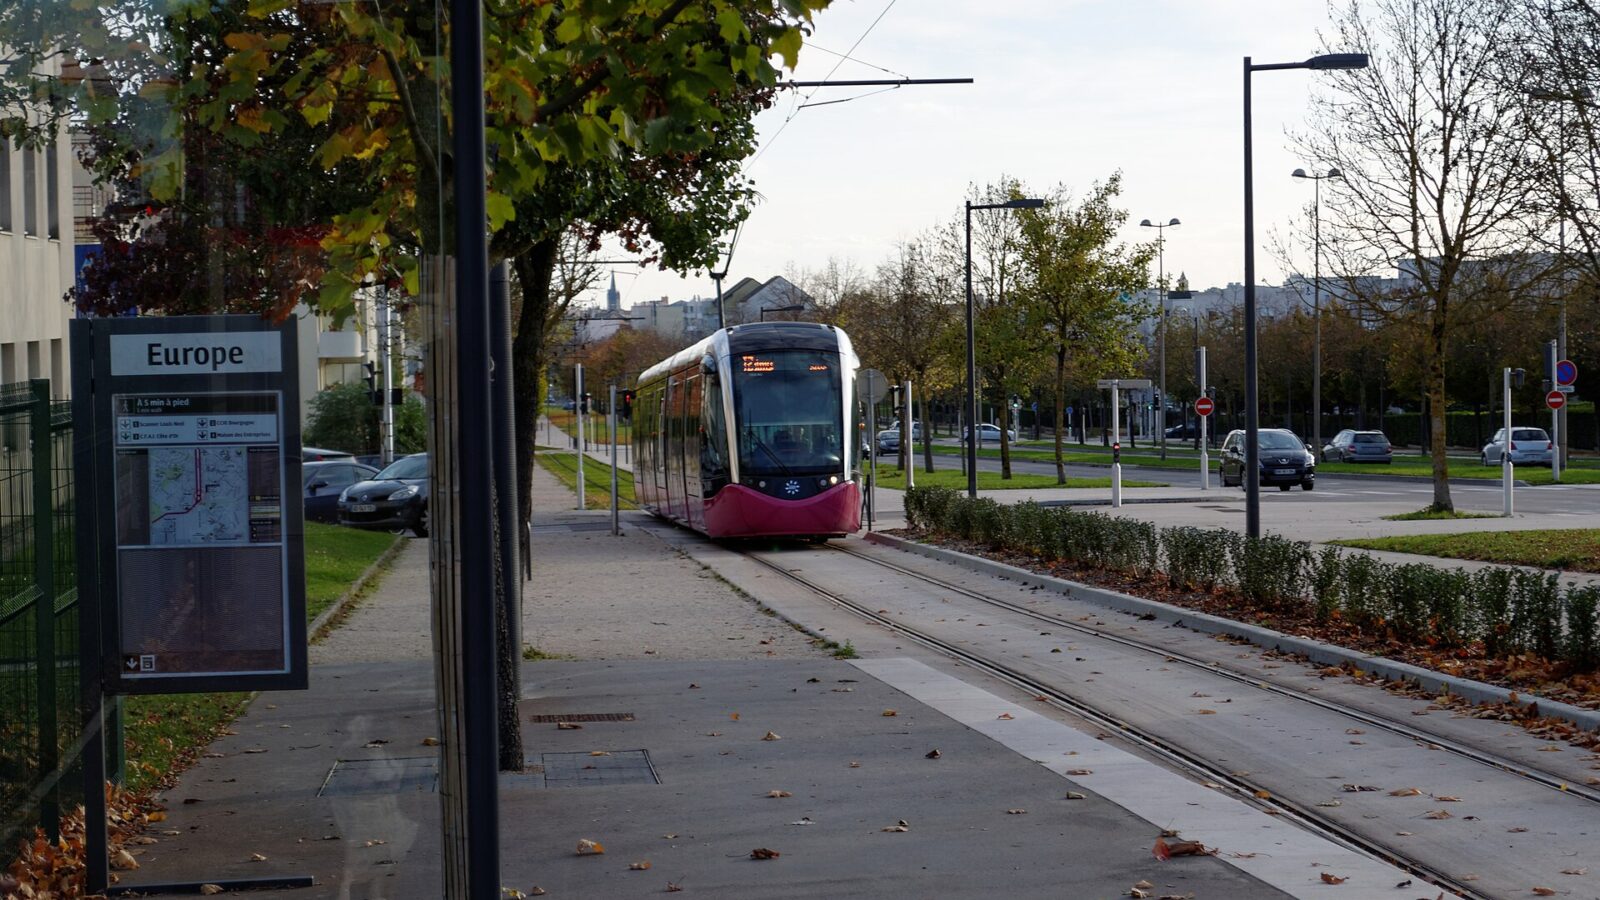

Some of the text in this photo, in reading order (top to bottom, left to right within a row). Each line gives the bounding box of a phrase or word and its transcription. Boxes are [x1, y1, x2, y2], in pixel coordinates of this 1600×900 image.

[147, 343, 243, 371] Europe
[150, 398, 164, 406] min
[166, 398, 171, 406] à
[172, 398, 189, 407] pied
